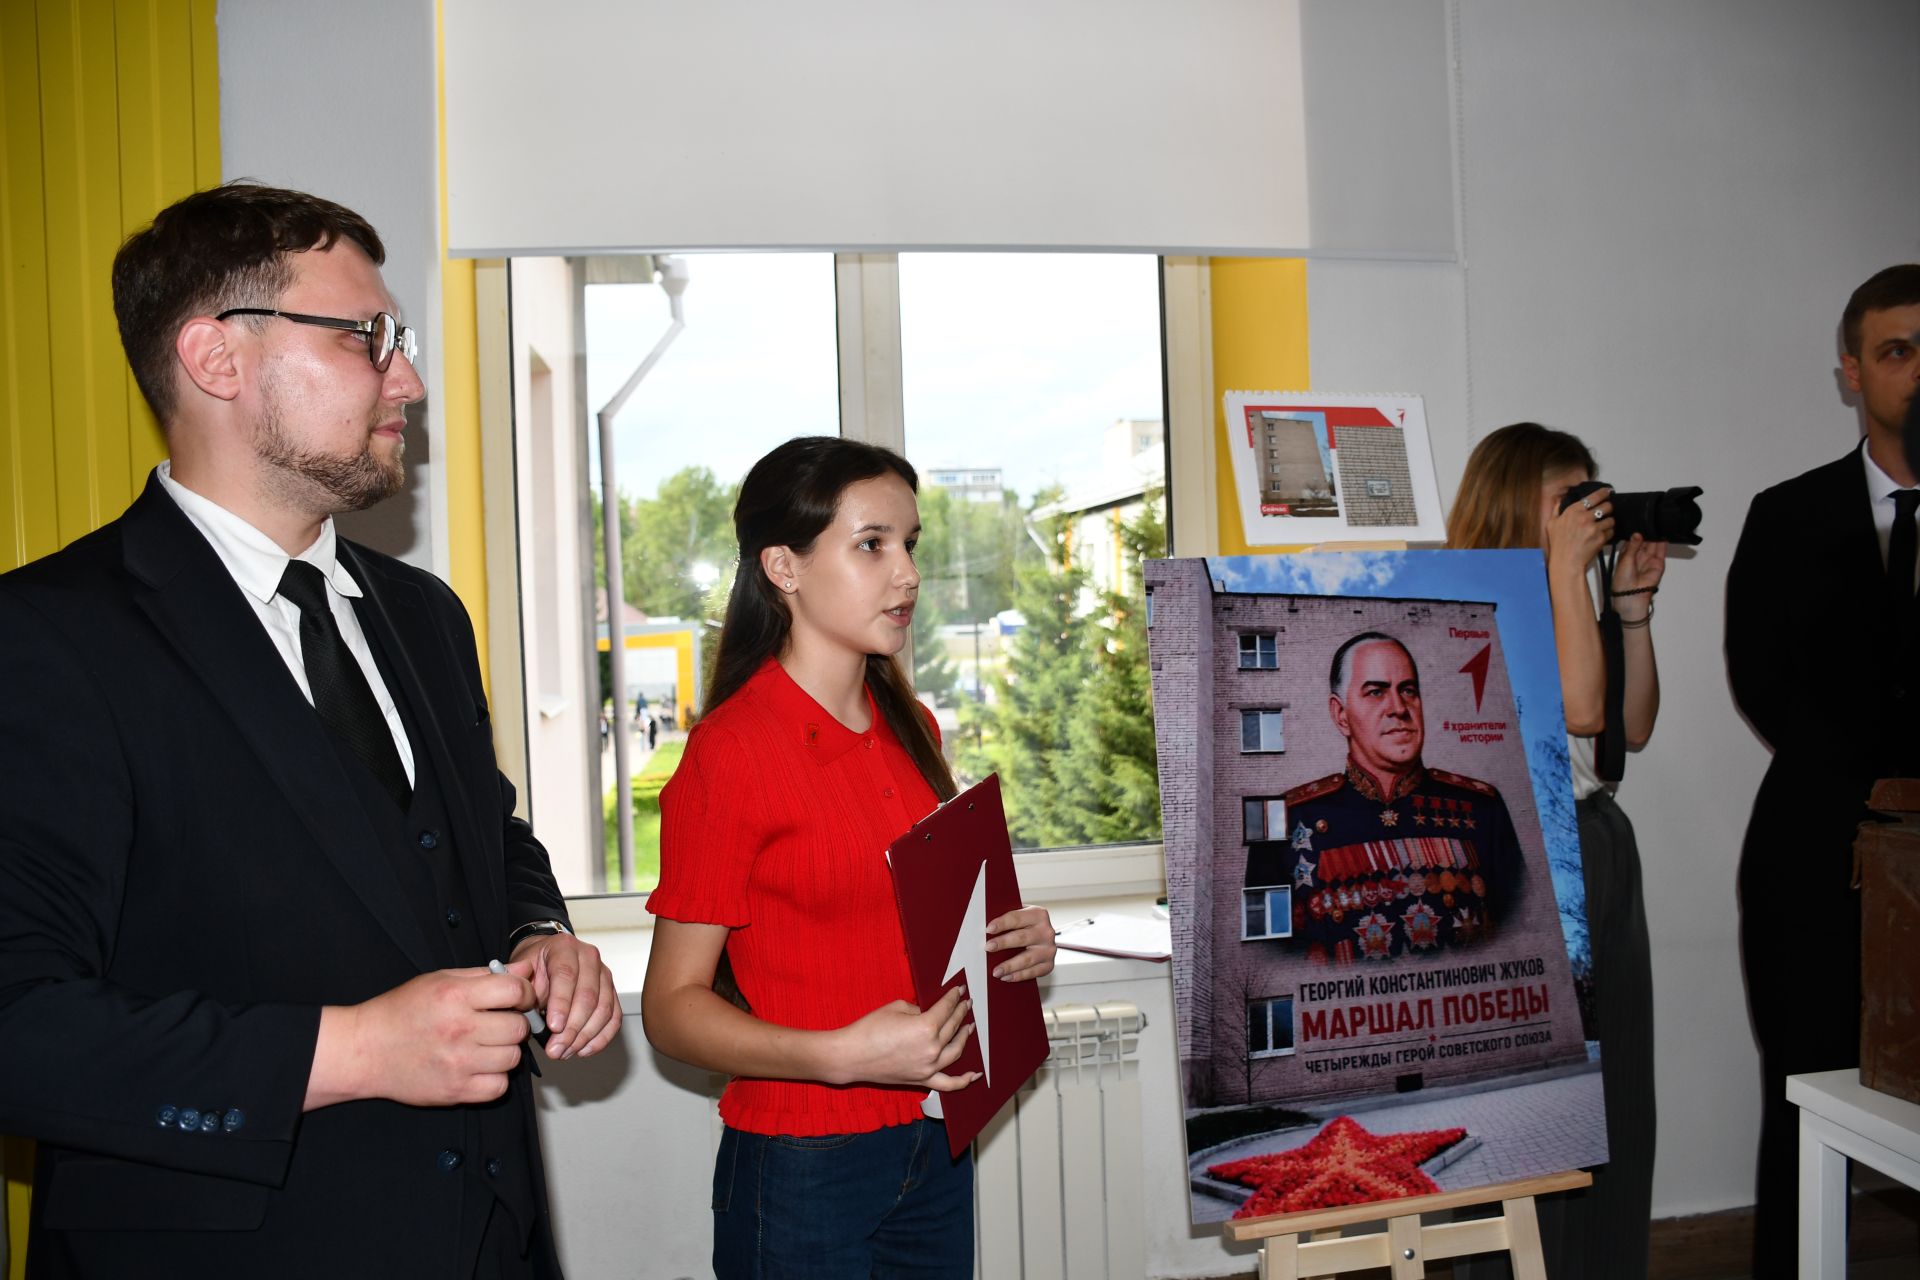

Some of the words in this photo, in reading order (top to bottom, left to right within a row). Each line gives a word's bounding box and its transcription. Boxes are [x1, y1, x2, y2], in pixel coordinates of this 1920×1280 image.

[1449, 627, 1490, 640] Первые
[1460, 734, 1504, 745] истории
[1300, 975, 1365, 1002] ГЕОРГИЙ
[1369, 963, 1497, 996] КОНСТАНТИНОВИЧ
[1499, 957, 1545, 981] ЖУКОВ
[1302, 999, 1435, 1042] МАРШАЛ
[1442, 983, 1550, 1027] ПОБЕДЫ
[1305, 1051, 1392, 1074] ЧЕТЫРЕЖДЫ
[1396, 1044, 1436, 1064] ГЕРОЙ
[1439, 1036, 1512, 1058] СОВЕТСКОГО
[1514, 1030, 1553, 1048] СОЮЗА
